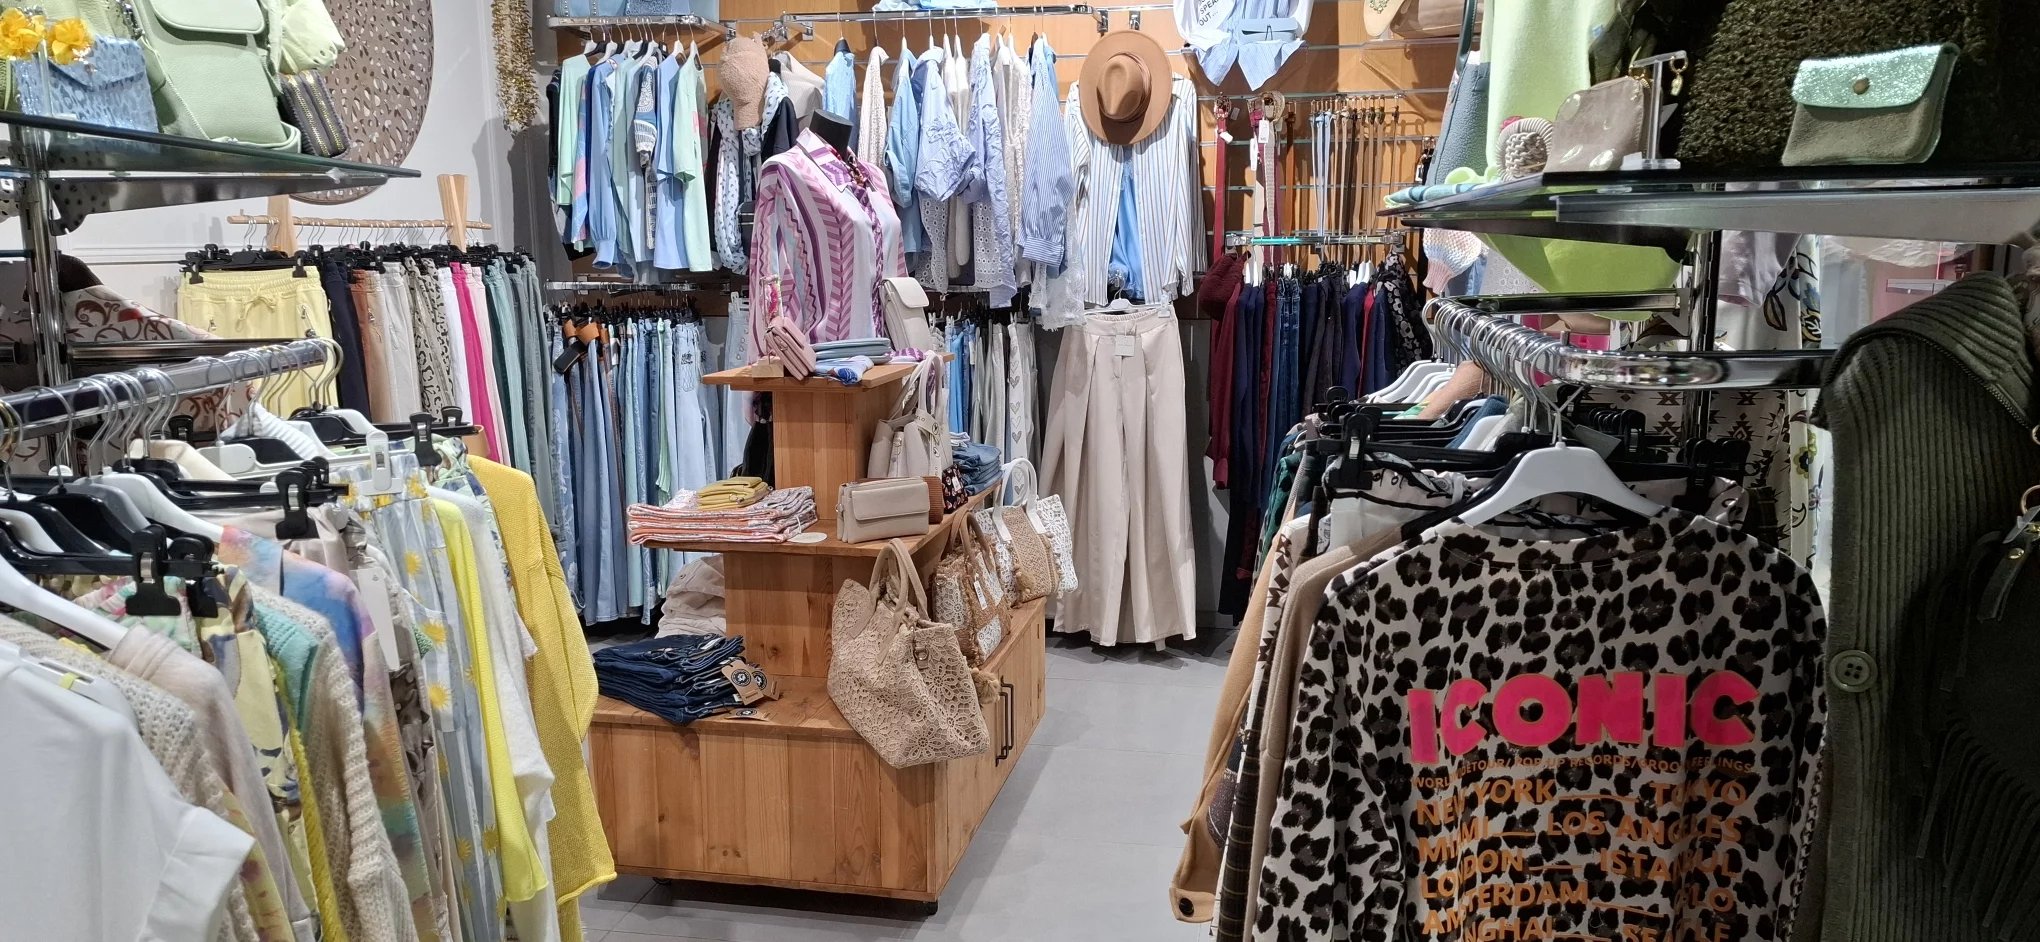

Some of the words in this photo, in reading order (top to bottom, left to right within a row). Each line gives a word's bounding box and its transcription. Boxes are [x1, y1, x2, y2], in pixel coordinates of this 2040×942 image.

[1200, 0, 1219, 14] SPEA
[1407, 670, 1760, 765] ICONIC
[1473, 778, 1557, 806] YORK
[1547, 810, 1607, 836] LOS
